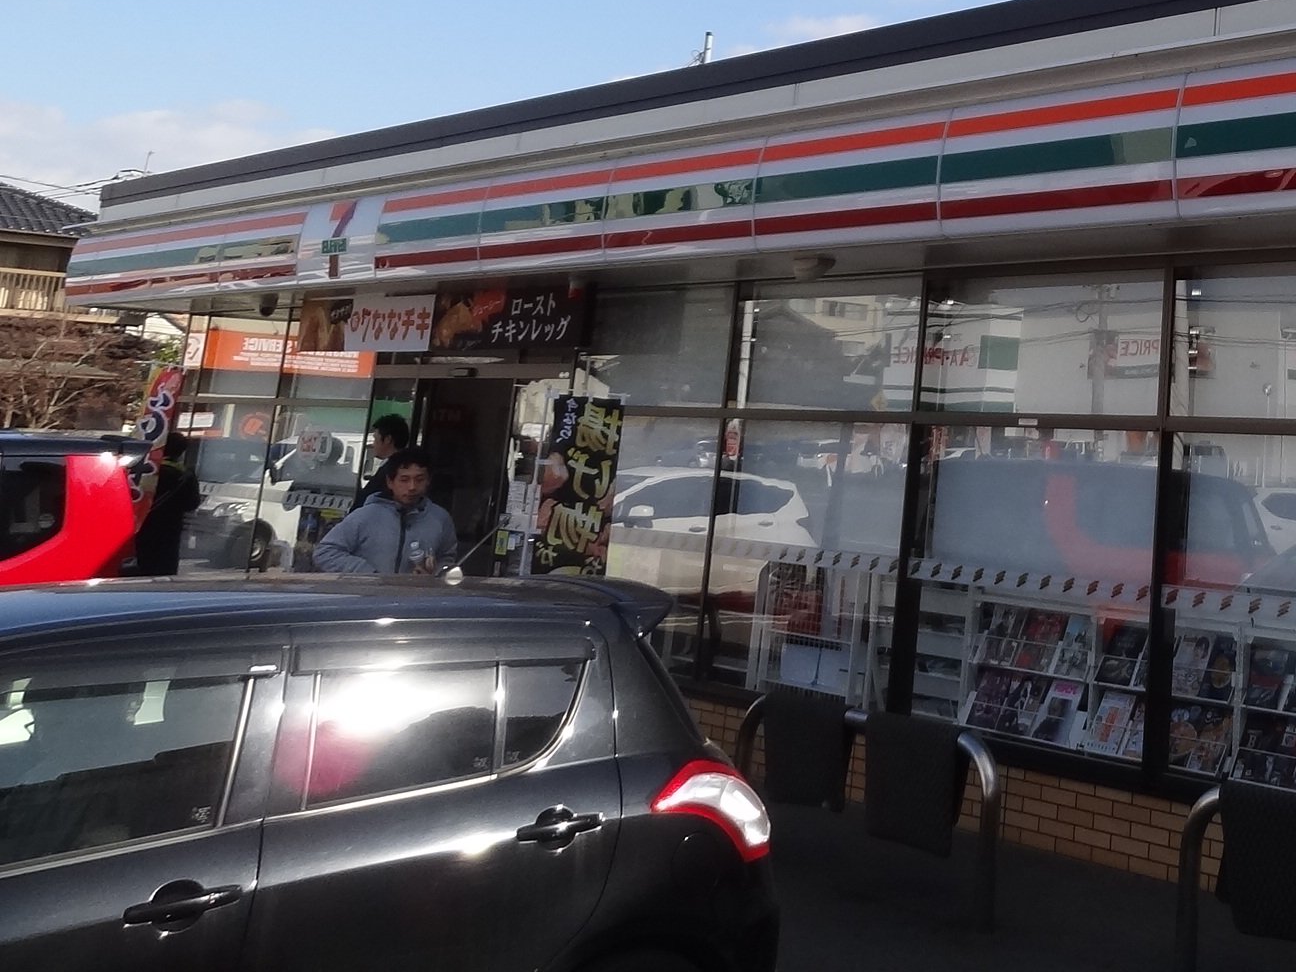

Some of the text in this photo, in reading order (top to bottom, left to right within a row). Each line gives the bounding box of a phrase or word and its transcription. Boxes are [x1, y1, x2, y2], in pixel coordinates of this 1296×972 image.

[511, 291, 557, 317] ロースト
[490, 314, 572, 345] チキンレッグ
